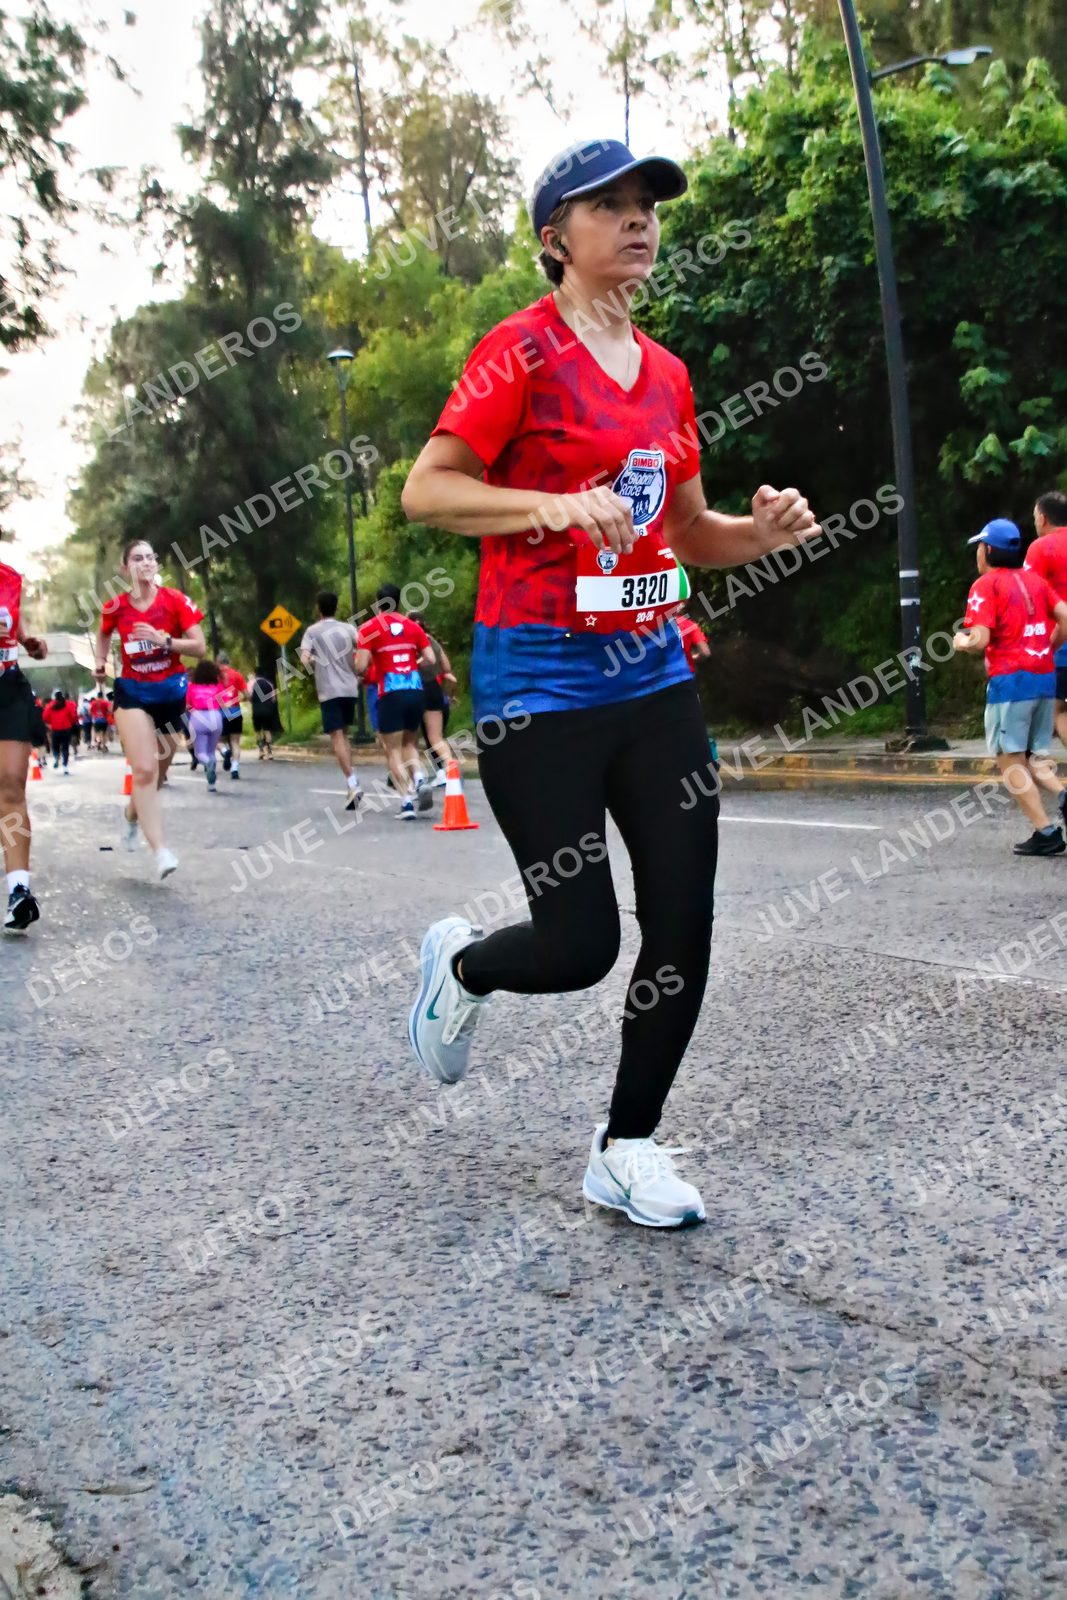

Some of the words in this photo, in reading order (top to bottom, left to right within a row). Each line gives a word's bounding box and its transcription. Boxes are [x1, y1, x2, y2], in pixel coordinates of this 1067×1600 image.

[633, 458, 660, 468] BIMBO
[620, 483, 642, 496] Race
[621, 573, 668, 608] 3320
